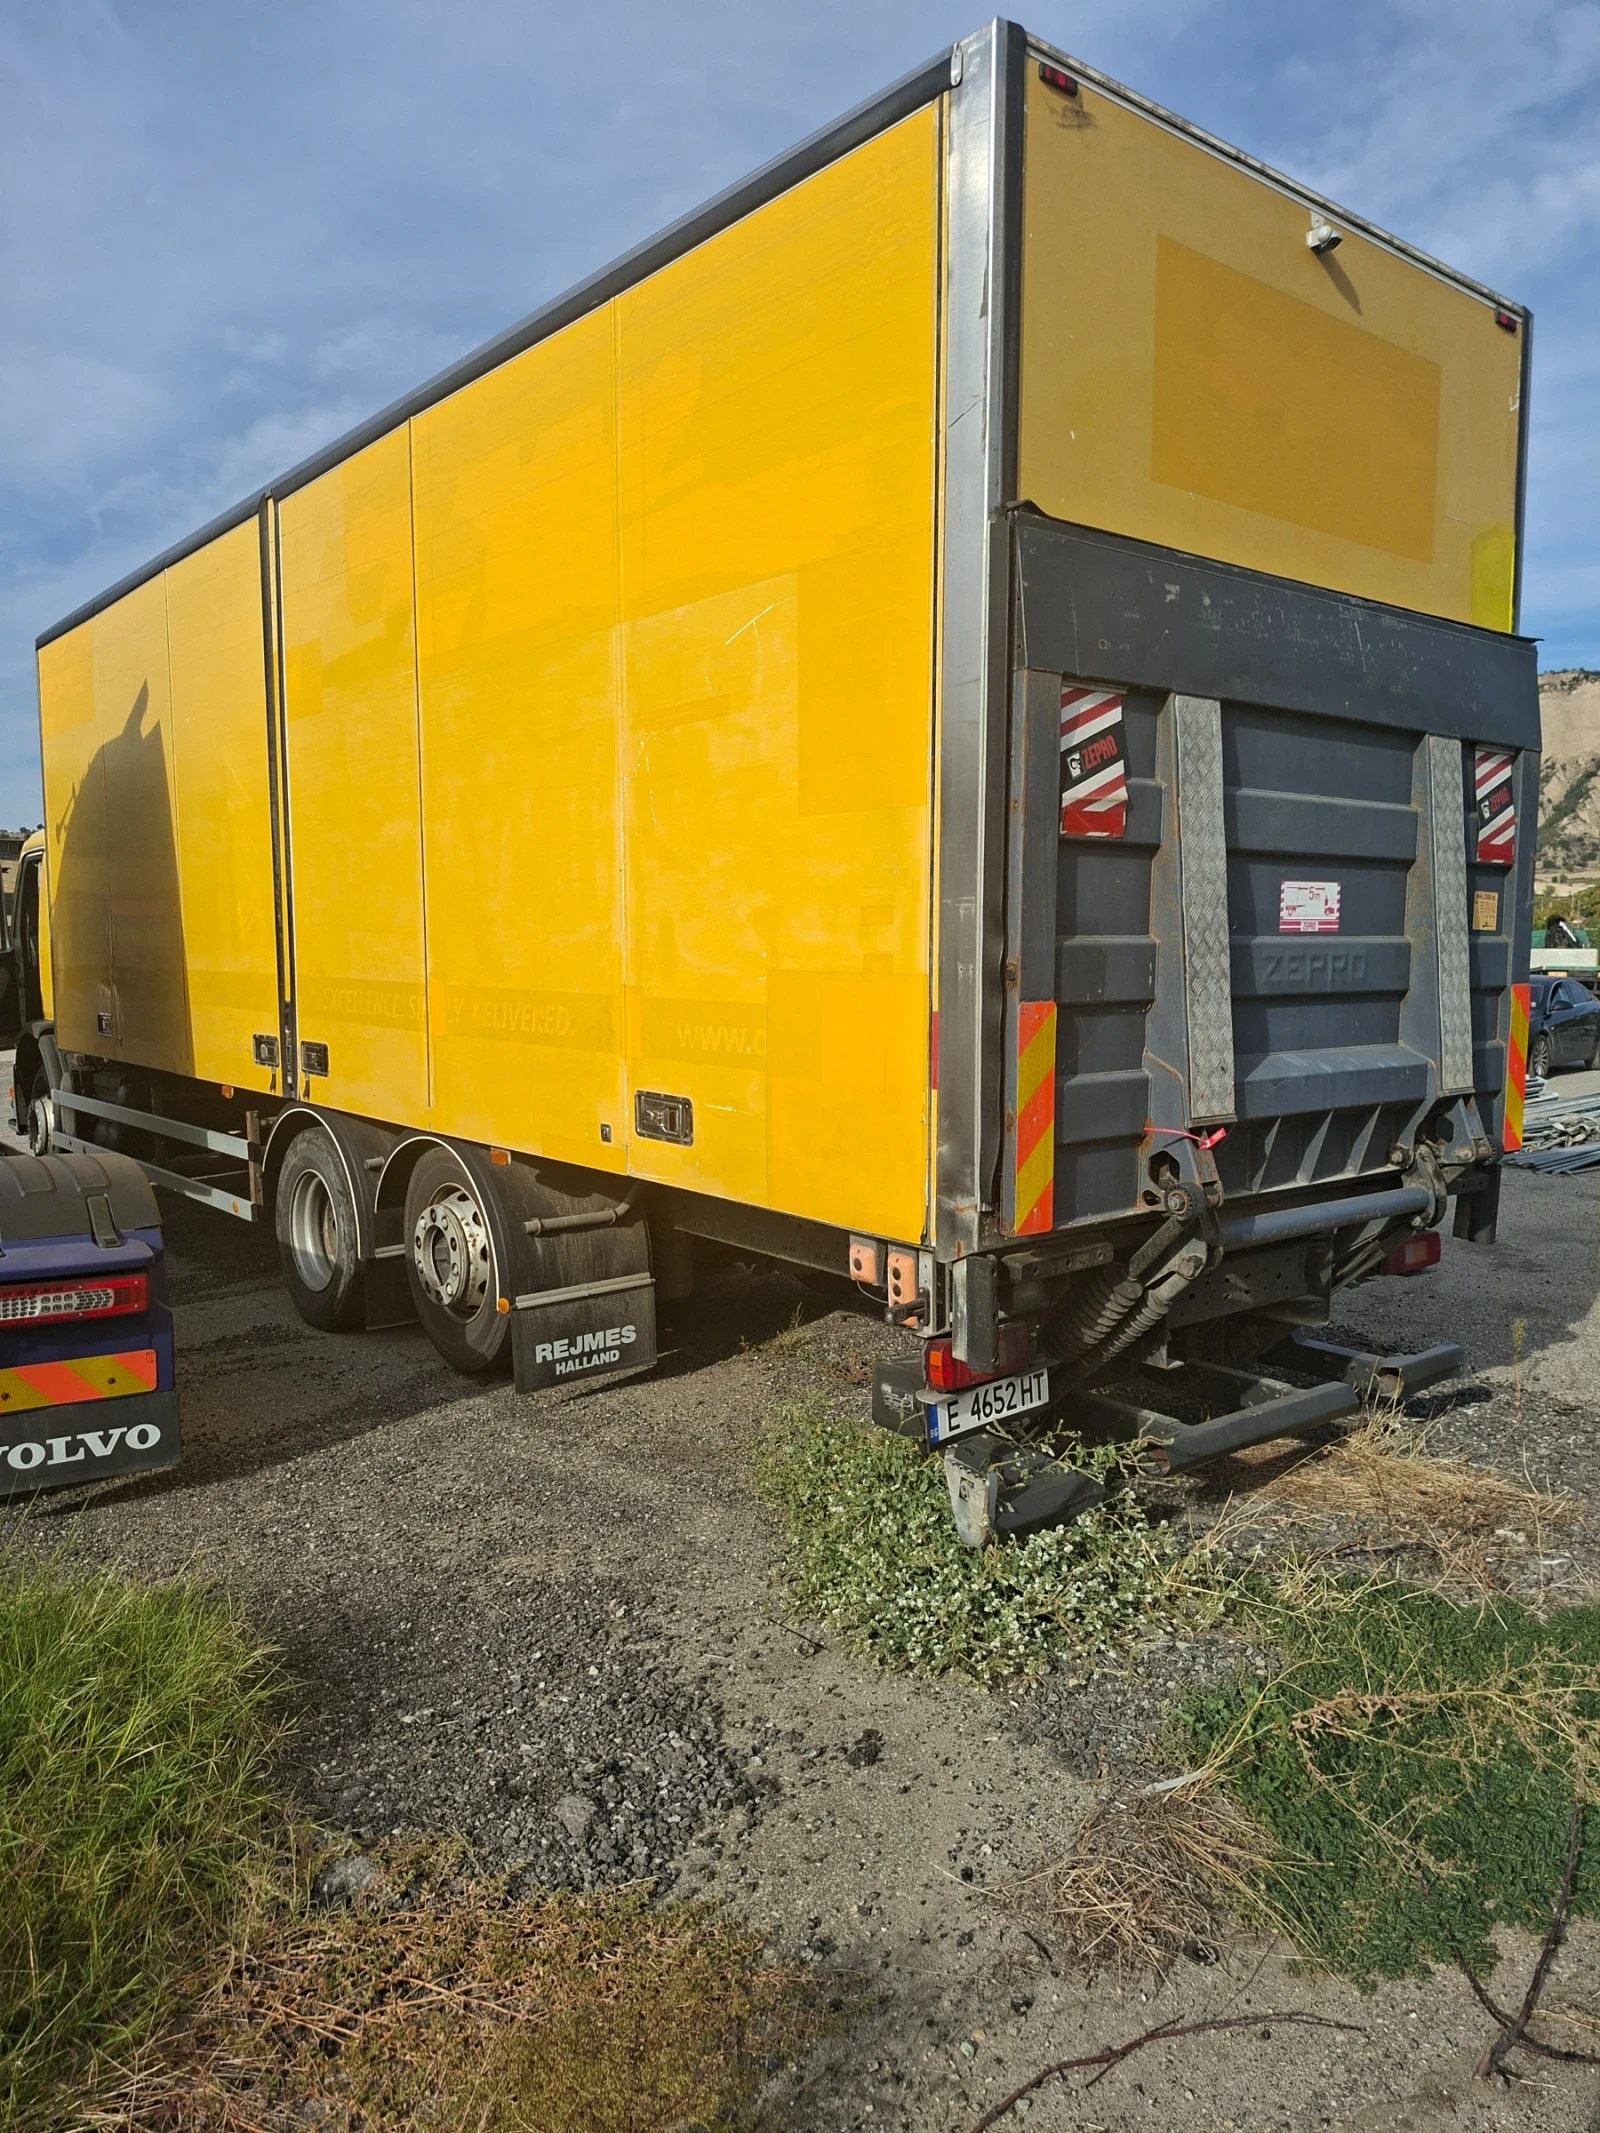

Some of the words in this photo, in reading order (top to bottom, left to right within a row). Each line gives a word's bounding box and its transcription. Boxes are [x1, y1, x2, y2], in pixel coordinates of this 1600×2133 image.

[1081, 735, 1118, 770] ZEPRO
[1489, 786, 1510, 814] ZEPRO
[1262, 950, 1368, 987] ZEPRO
[535, 1324, 637, 1364] REJMES
[555, 1350, 620, 1376] HALLAND
[947, 1398, 960, 1432] E
[970, 1381, 1017, 1421] 4652
[1021, 1371, 1045, 1407] HT
